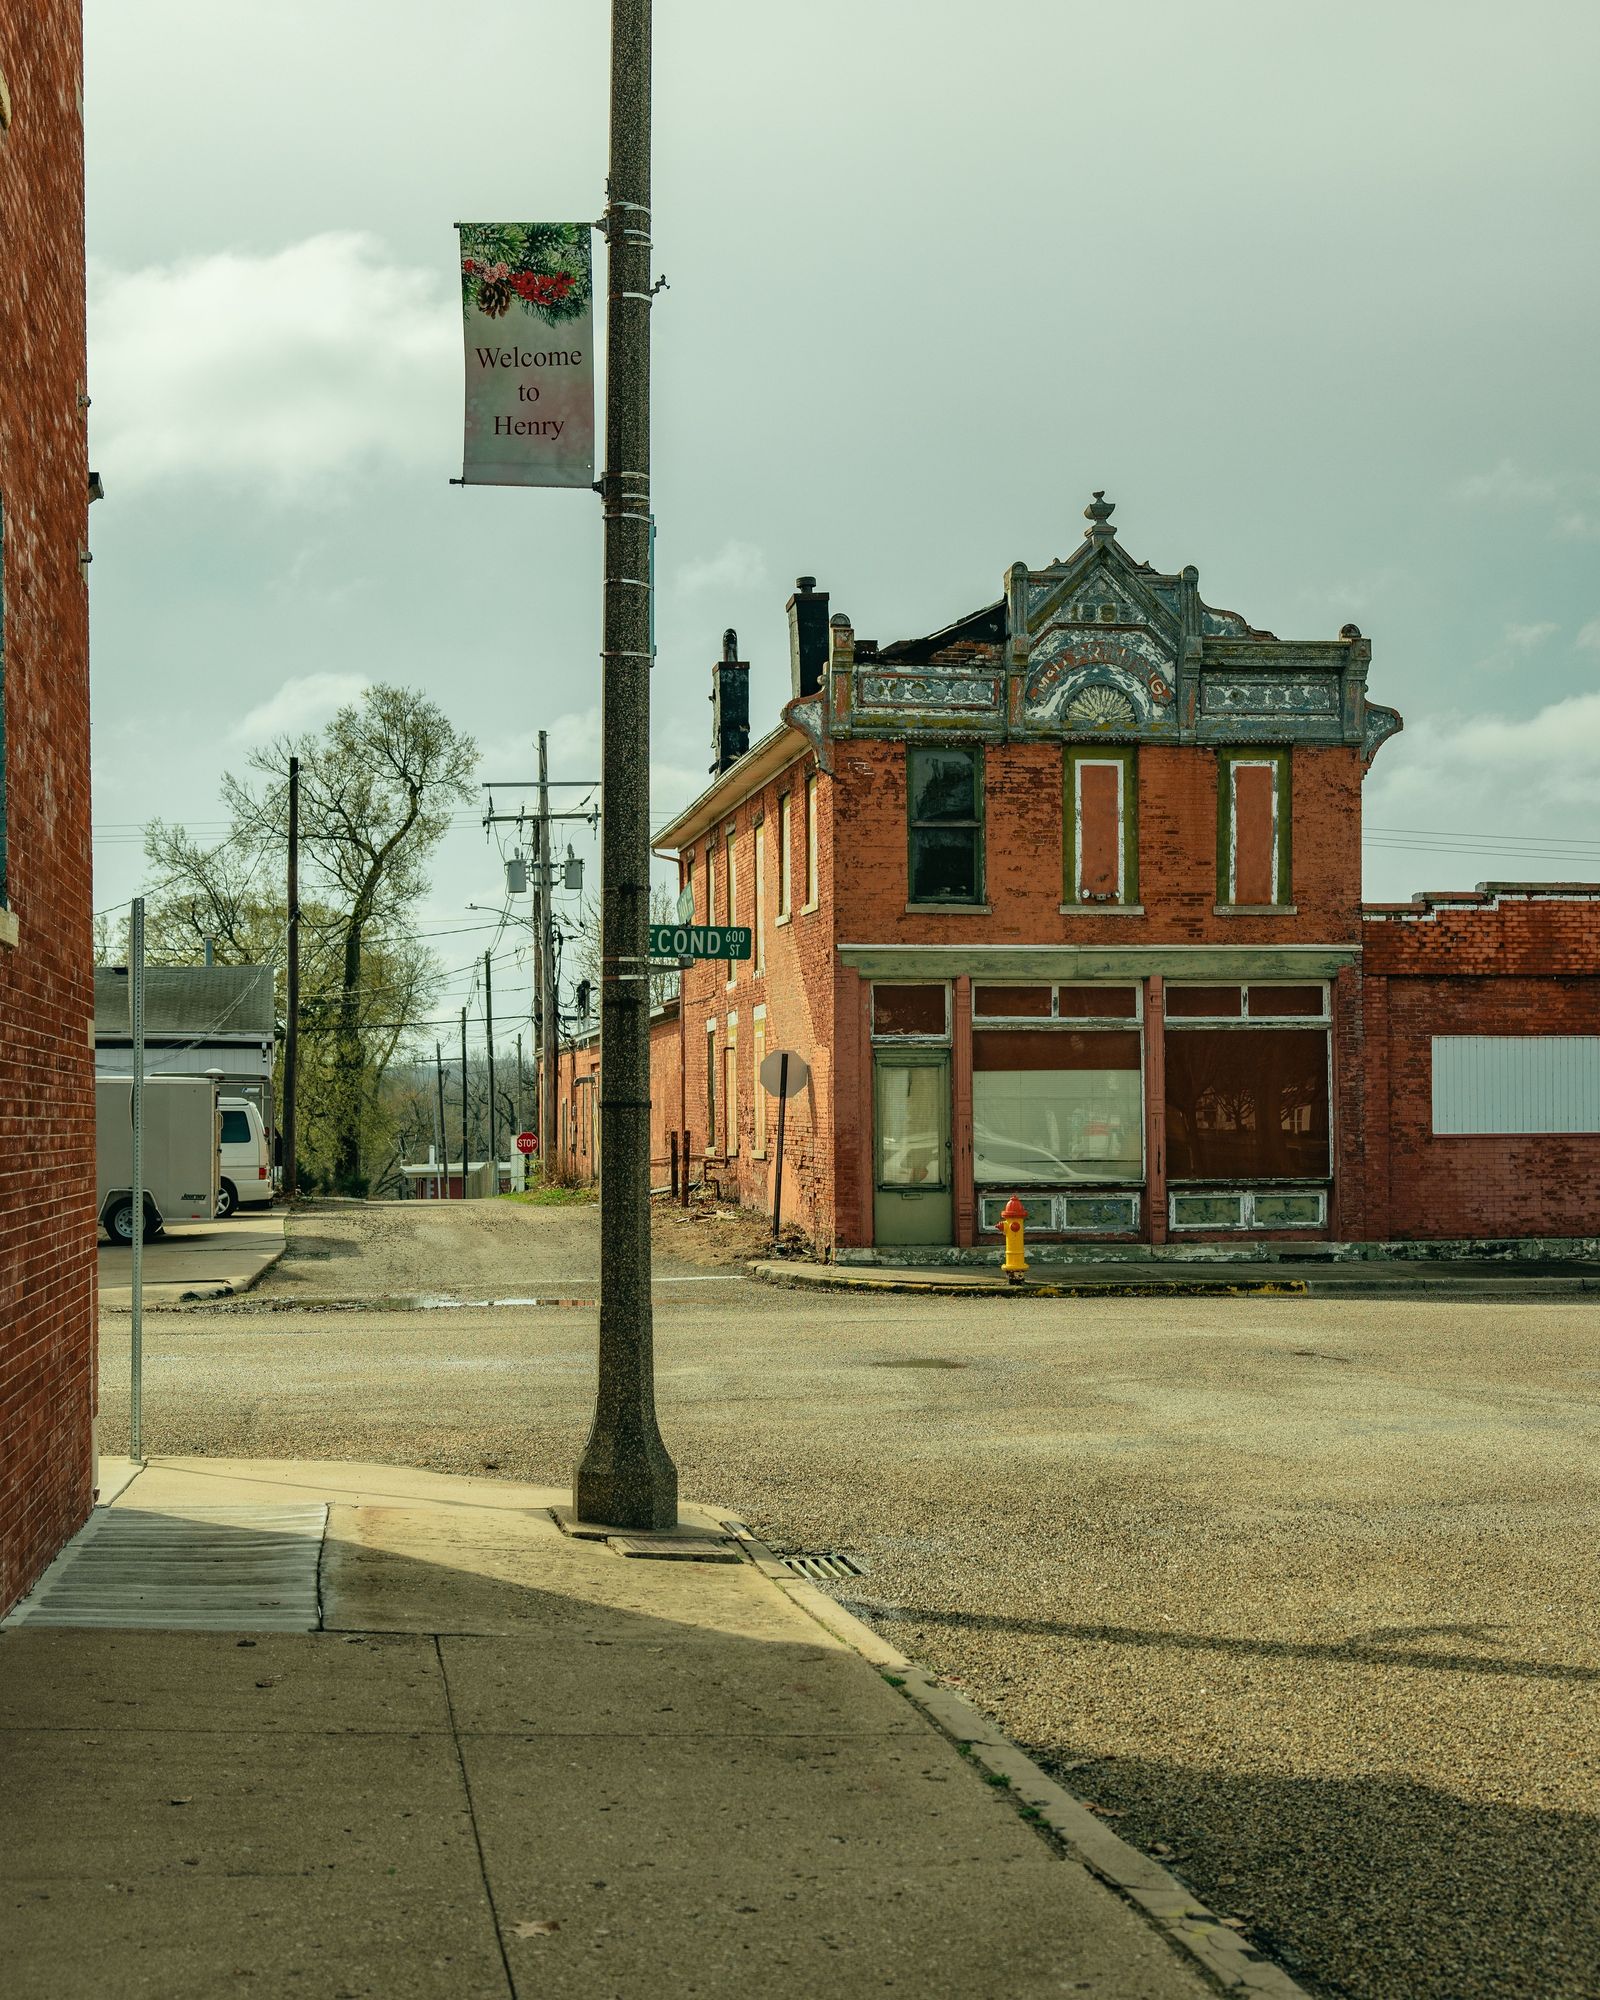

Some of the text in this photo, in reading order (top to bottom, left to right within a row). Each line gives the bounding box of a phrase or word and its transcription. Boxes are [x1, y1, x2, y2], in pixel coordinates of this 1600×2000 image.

[475, 346, 582, 369] Welcome
[518, 383, 540, 402] to
[494, 415, 565, 441] Henry
[650, 929, 721, 955] ECOND
[725, 930, 745, 943] 600
[729, 944, 741, 956] ST
[517, 1138, 537, 1148] STOP
